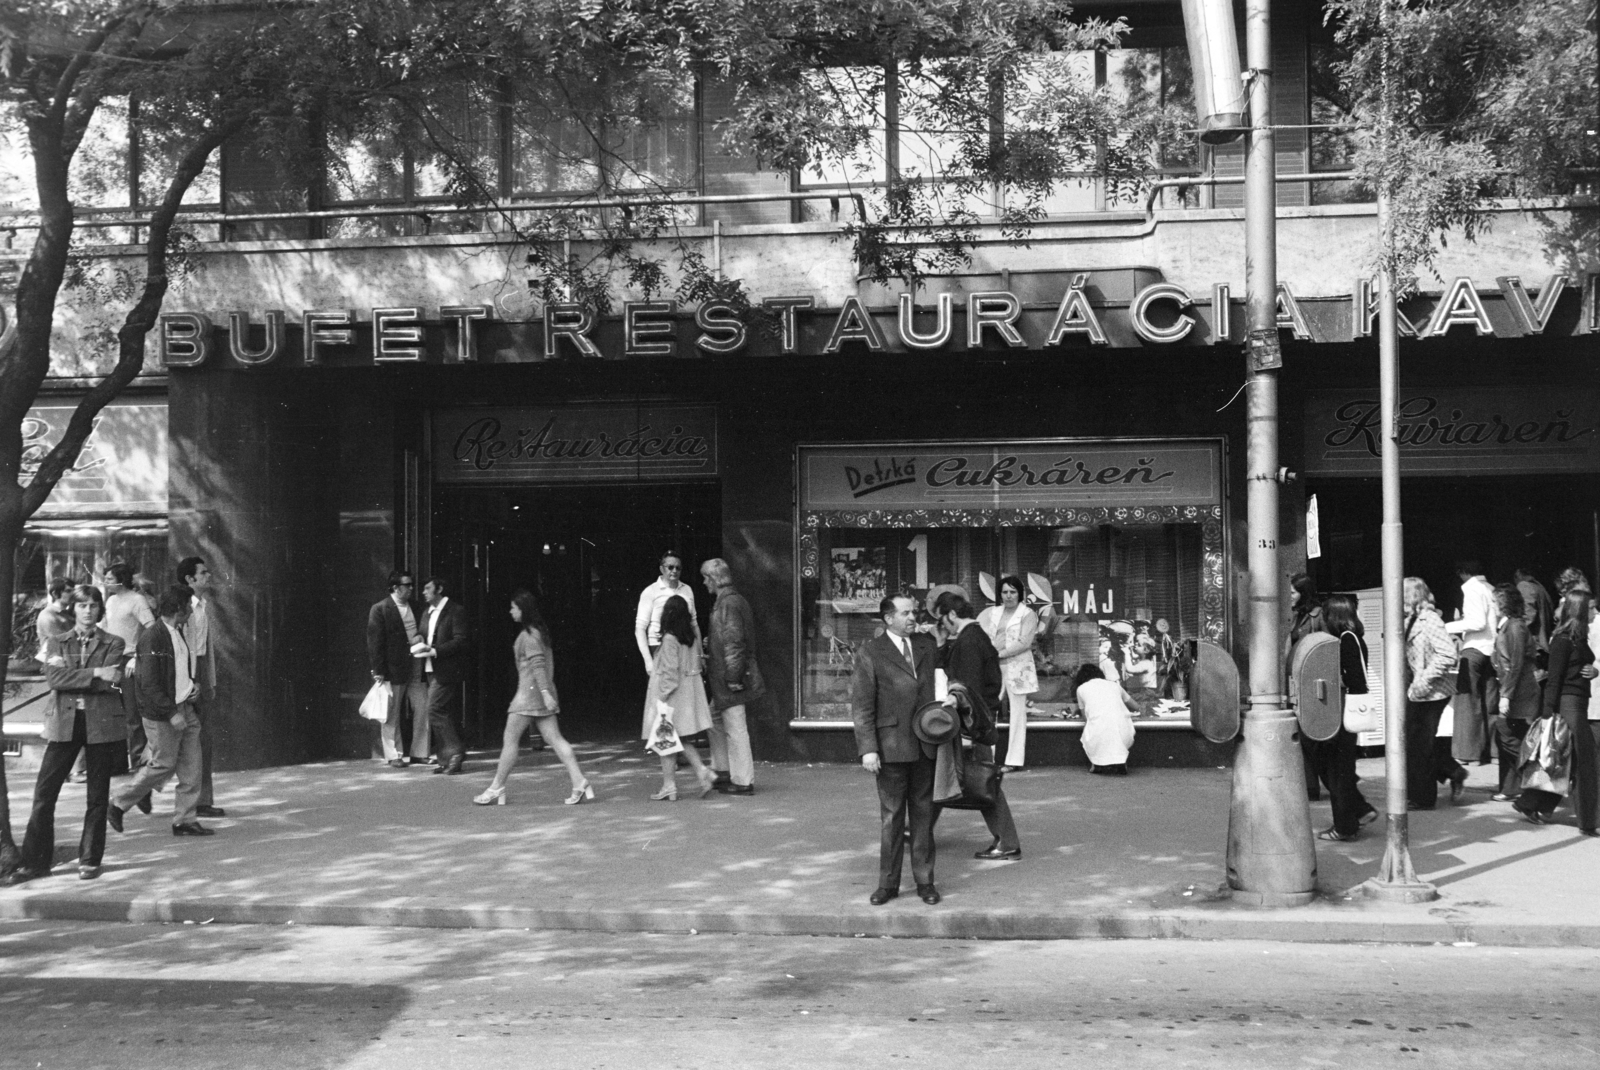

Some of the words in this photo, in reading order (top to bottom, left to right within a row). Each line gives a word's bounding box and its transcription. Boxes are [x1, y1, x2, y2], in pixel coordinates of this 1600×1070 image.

[160, 304, 490, 366] BUFET
[453, 416, 709, 470] Reštaurácia
[926, 456, 1175, 487] Cukráreň
[1062, 583, 1114, 615] MÁJ
